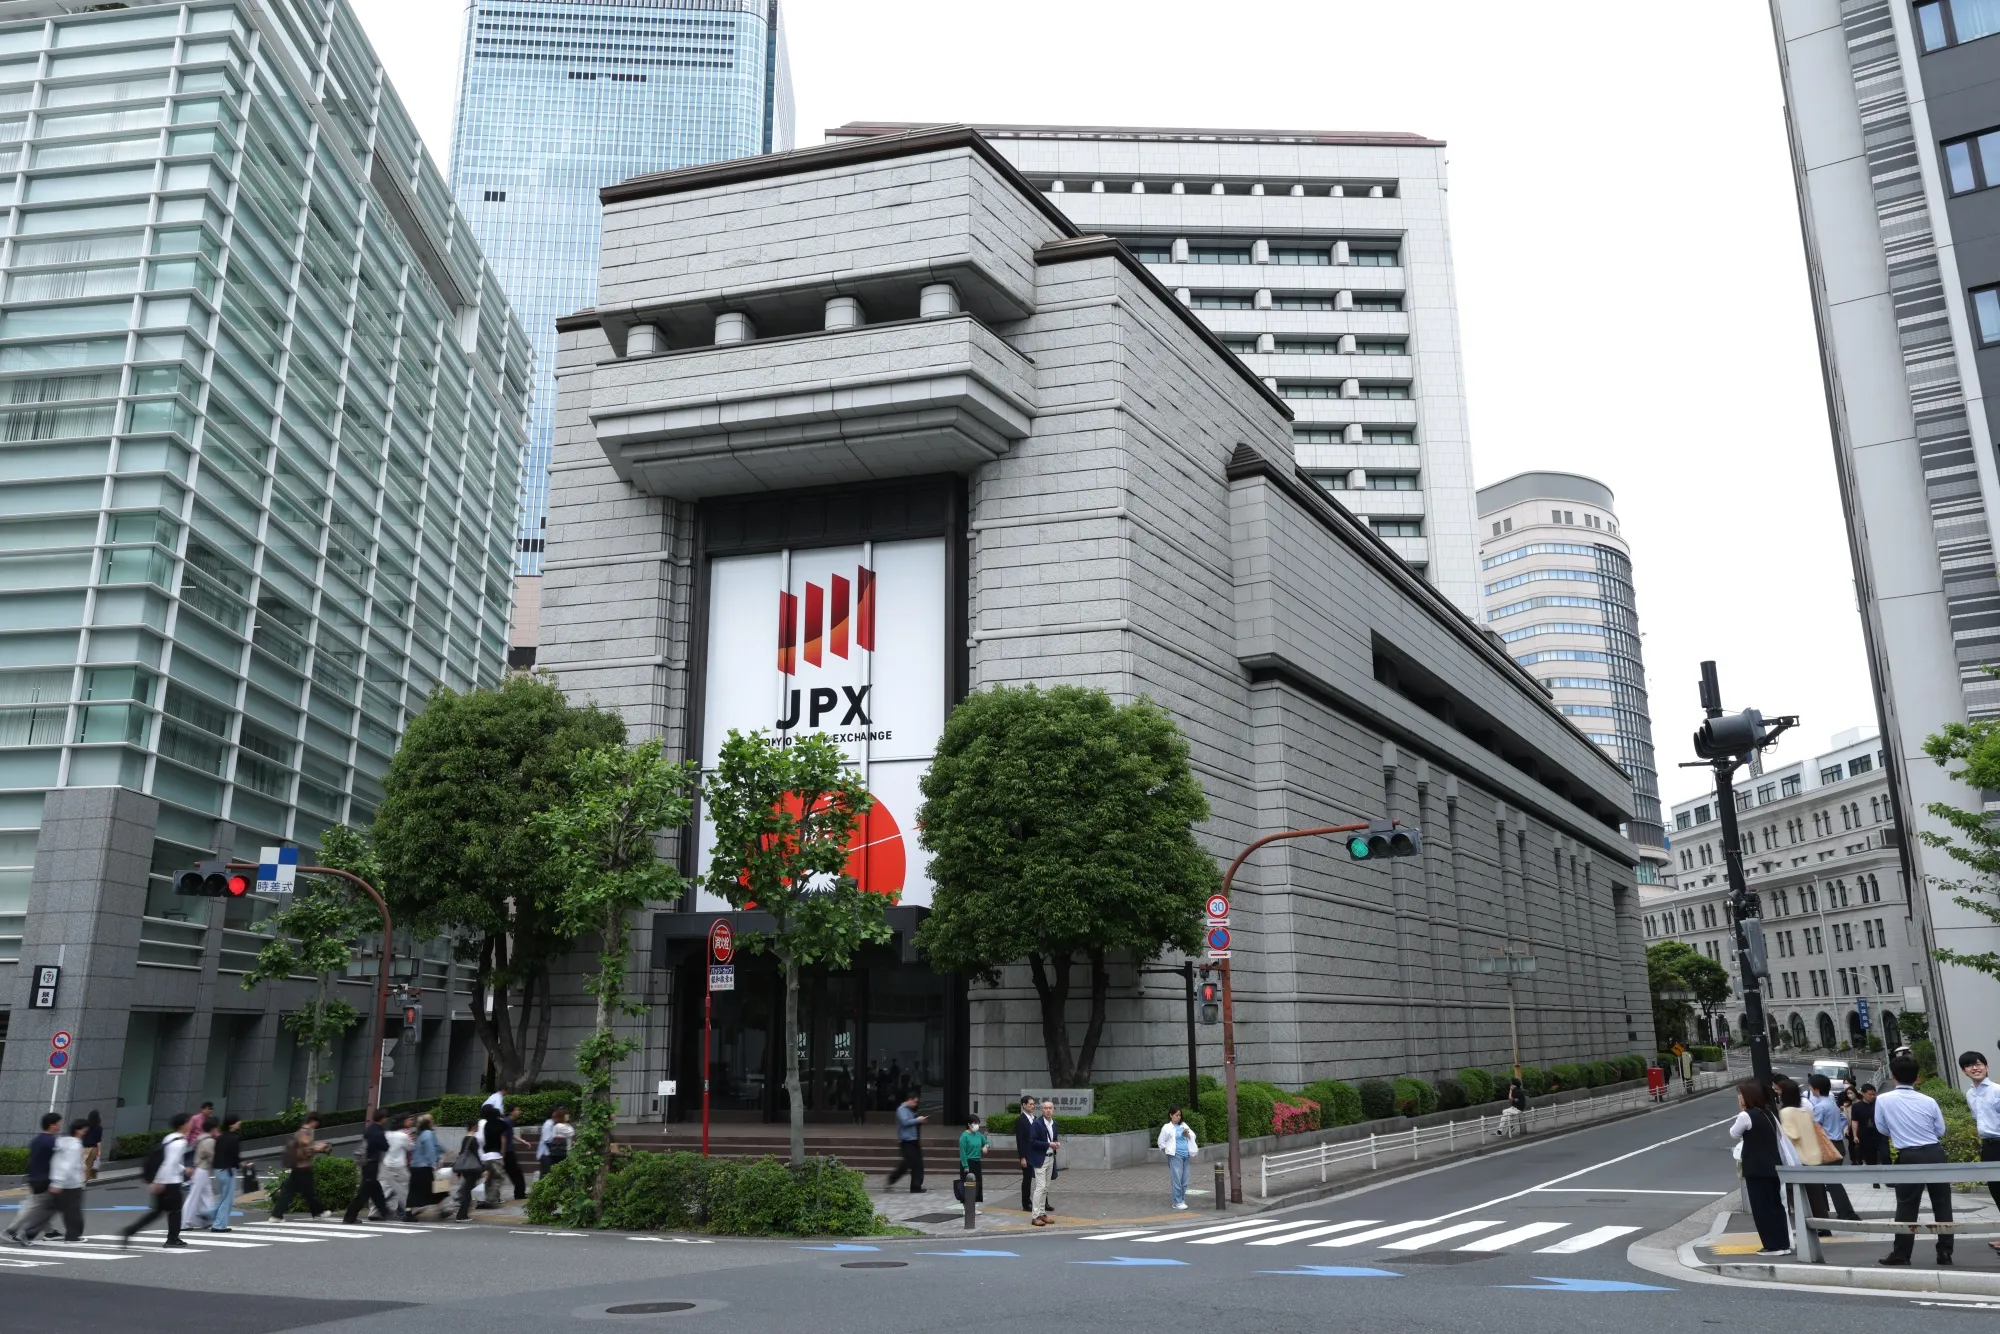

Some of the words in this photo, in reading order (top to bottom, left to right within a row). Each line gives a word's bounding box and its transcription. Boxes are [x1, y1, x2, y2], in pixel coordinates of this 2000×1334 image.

[775, 684, 873, 730] JPX
[833, 731, 892, 743] EXCHANGE
[257, 882, 293, 892] 時差式
[1211, 902, 1224, 912] 30
[715, 936, 730, 950] 消火栓
